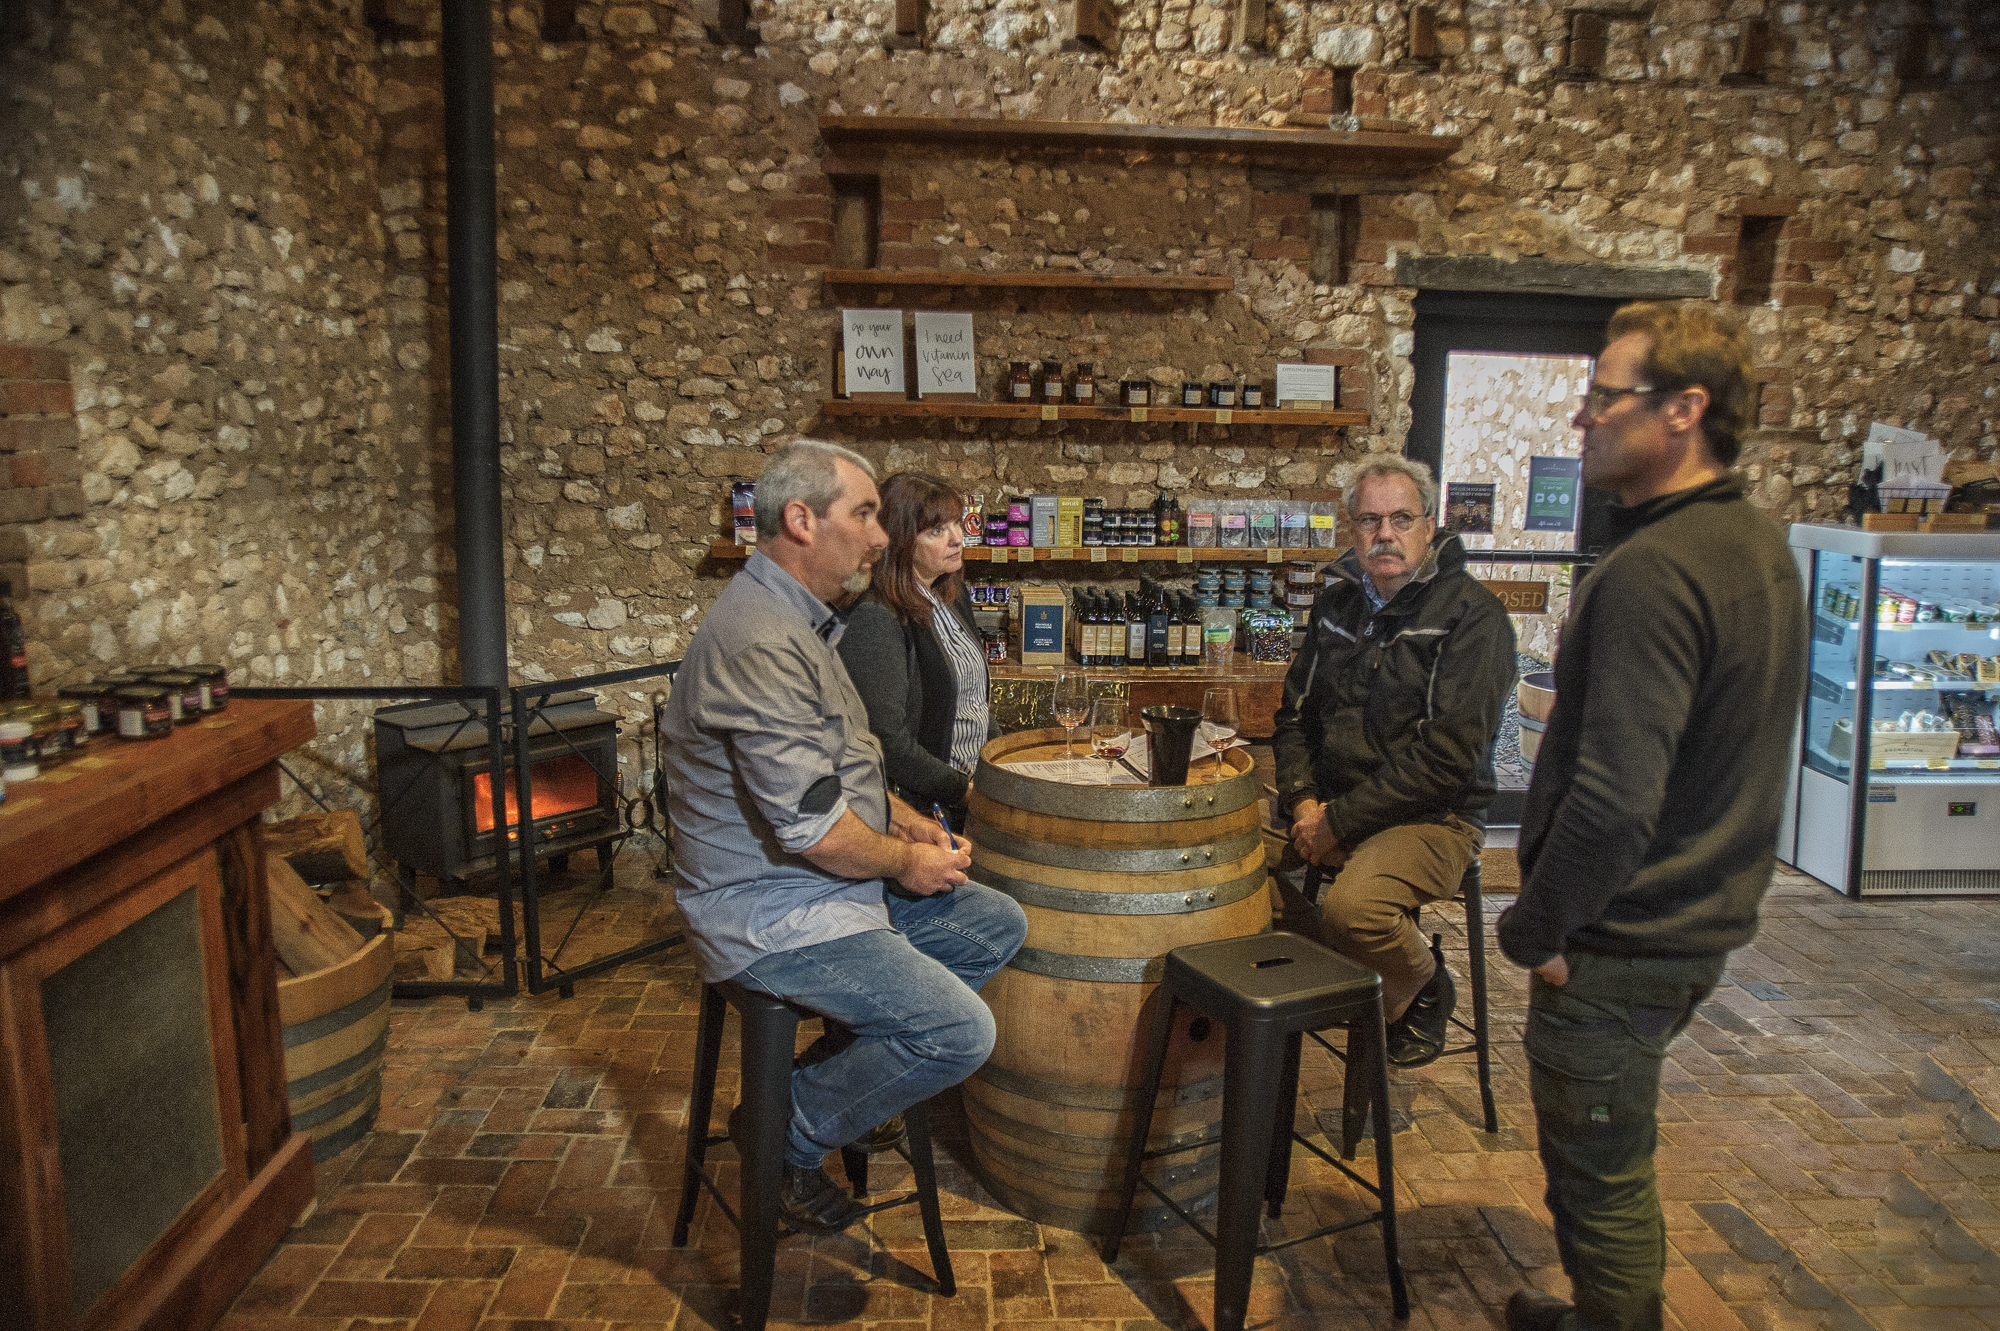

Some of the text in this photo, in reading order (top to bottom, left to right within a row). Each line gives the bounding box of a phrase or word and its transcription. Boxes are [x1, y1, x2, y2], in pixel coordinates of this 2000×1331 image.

[852, 323, 893, 337] go your
[935, 329, 963, 344] need
[1496, 591, 1545, 607] OSED
